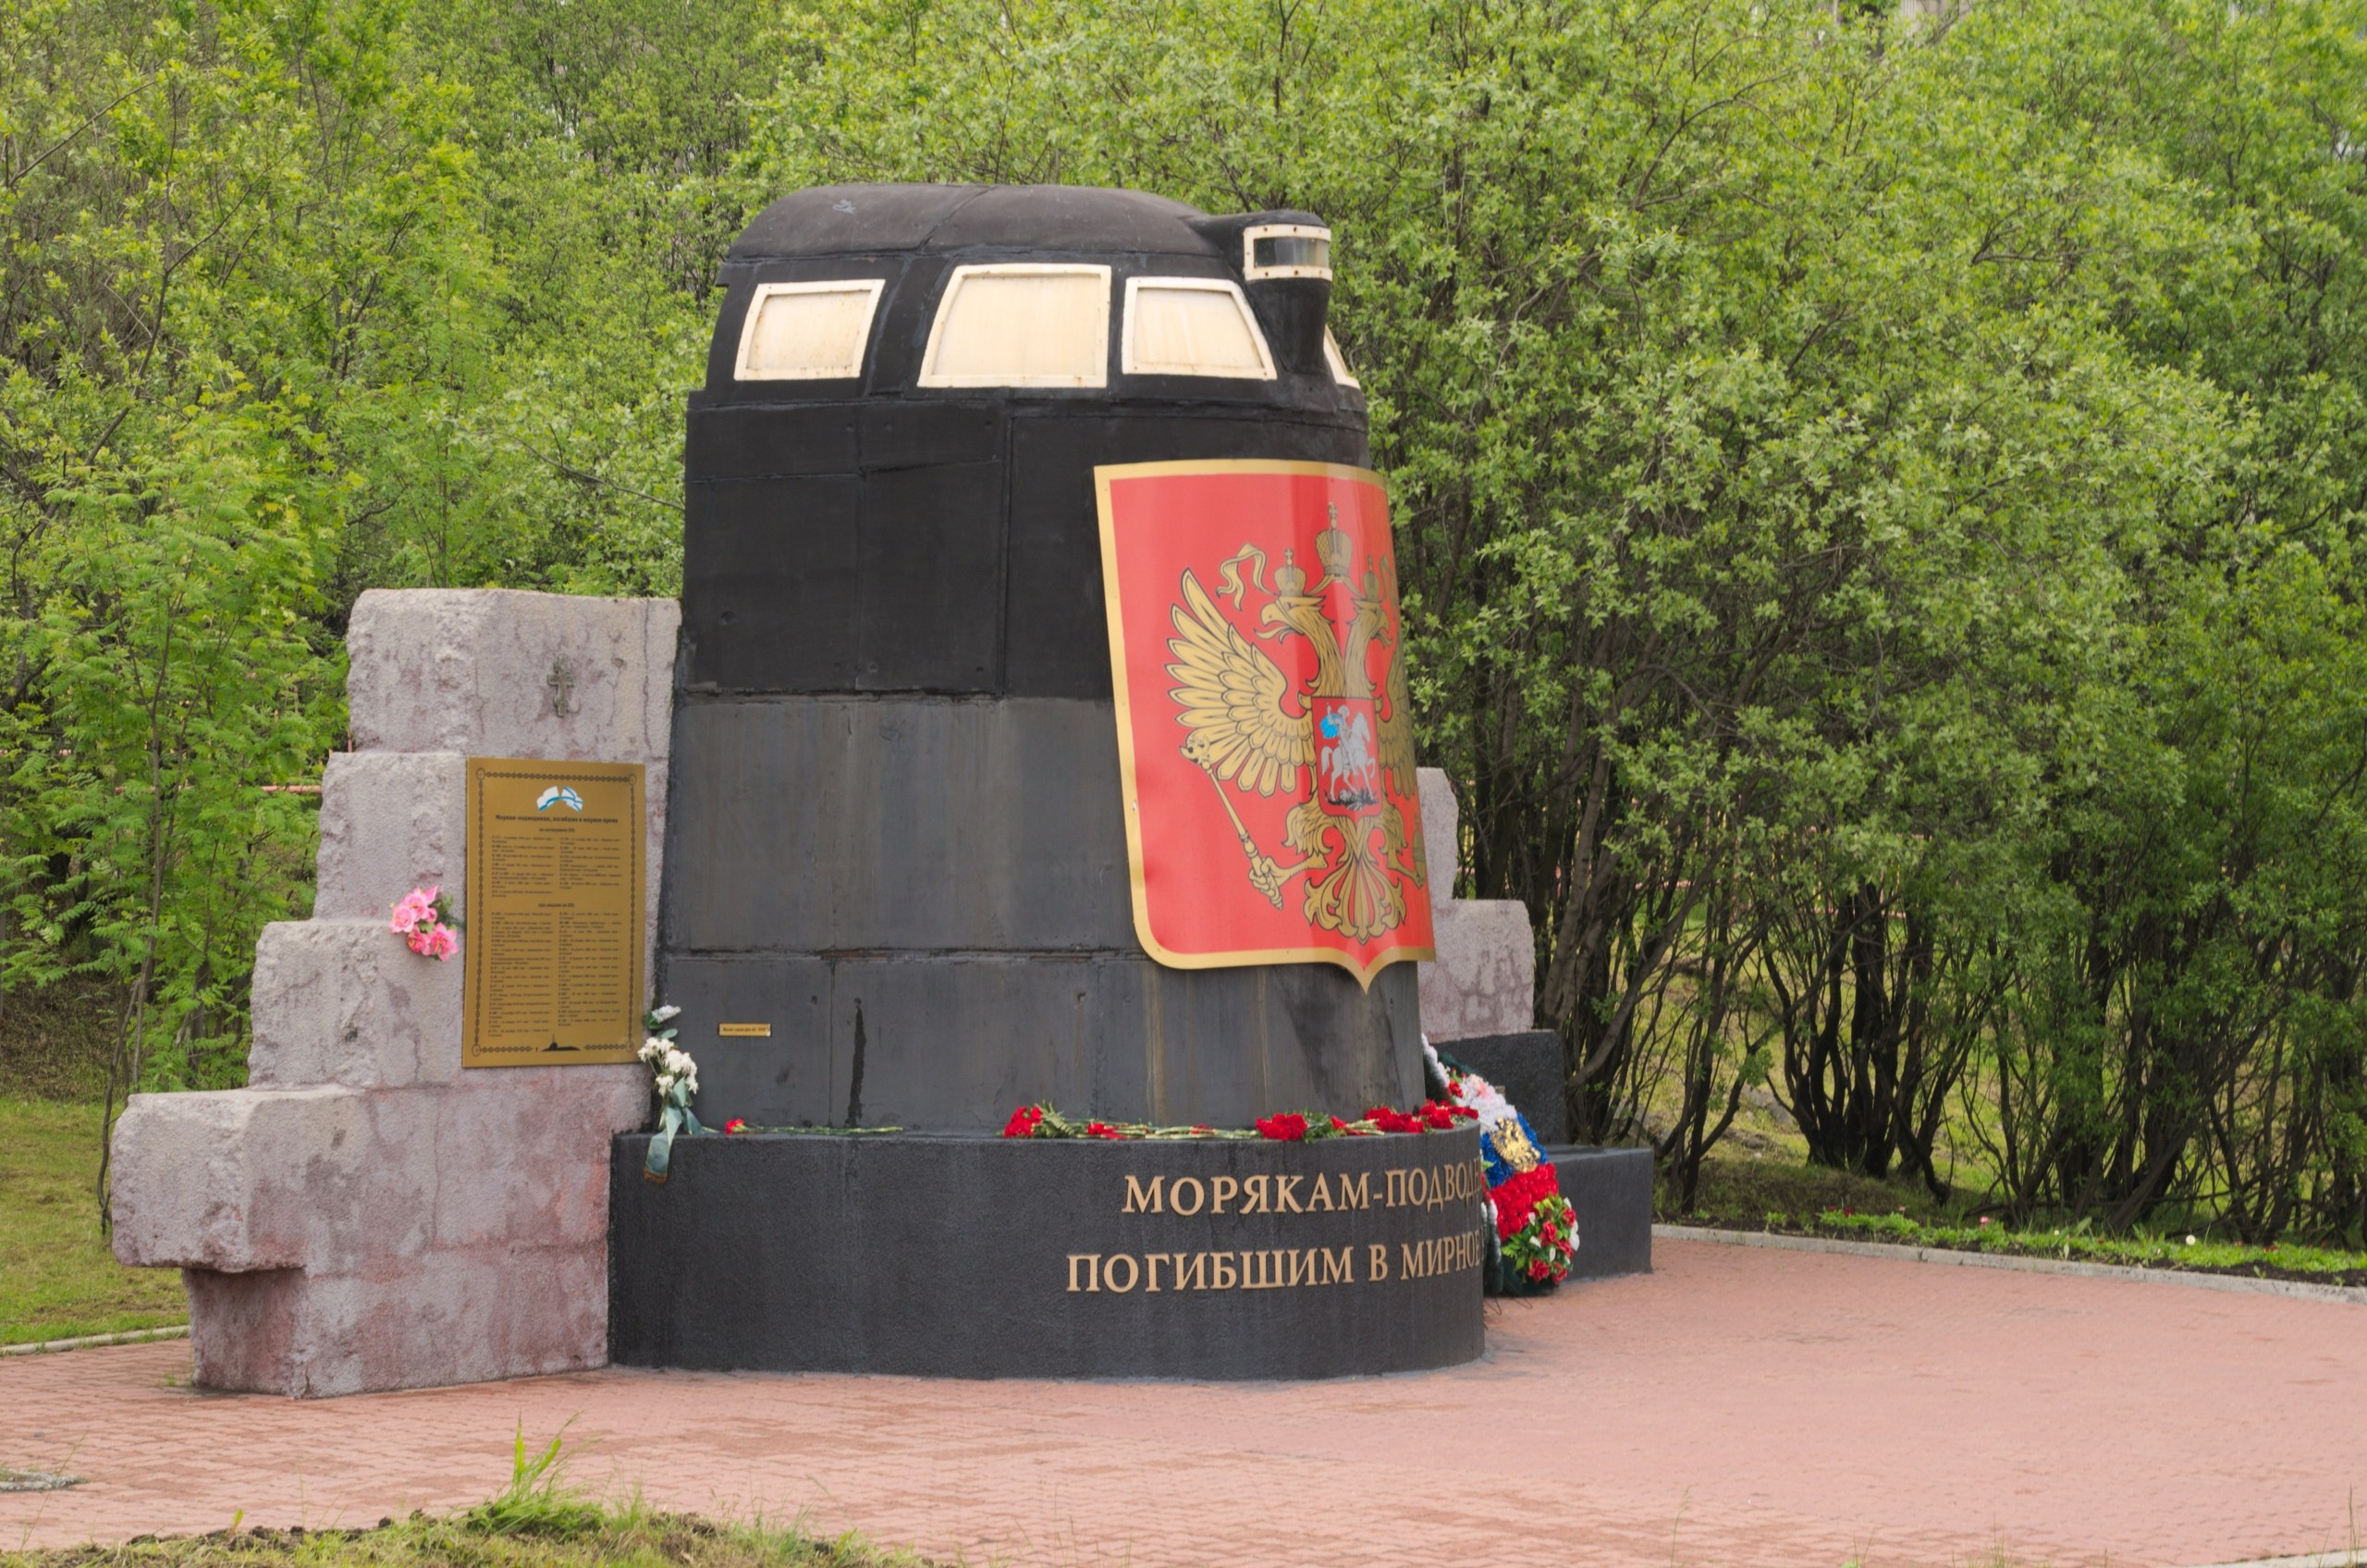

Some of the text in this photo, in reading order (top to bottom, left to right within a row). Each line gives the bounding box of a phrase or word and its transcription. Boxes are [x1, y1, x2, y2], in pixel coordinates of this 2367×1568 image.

[1066, 1246, 1355, 1293] ПОГИБШИМ
[1368, 1243, 1389, 1282] В
[1399, 1229, 1479, 1282] МИРНОЕ
